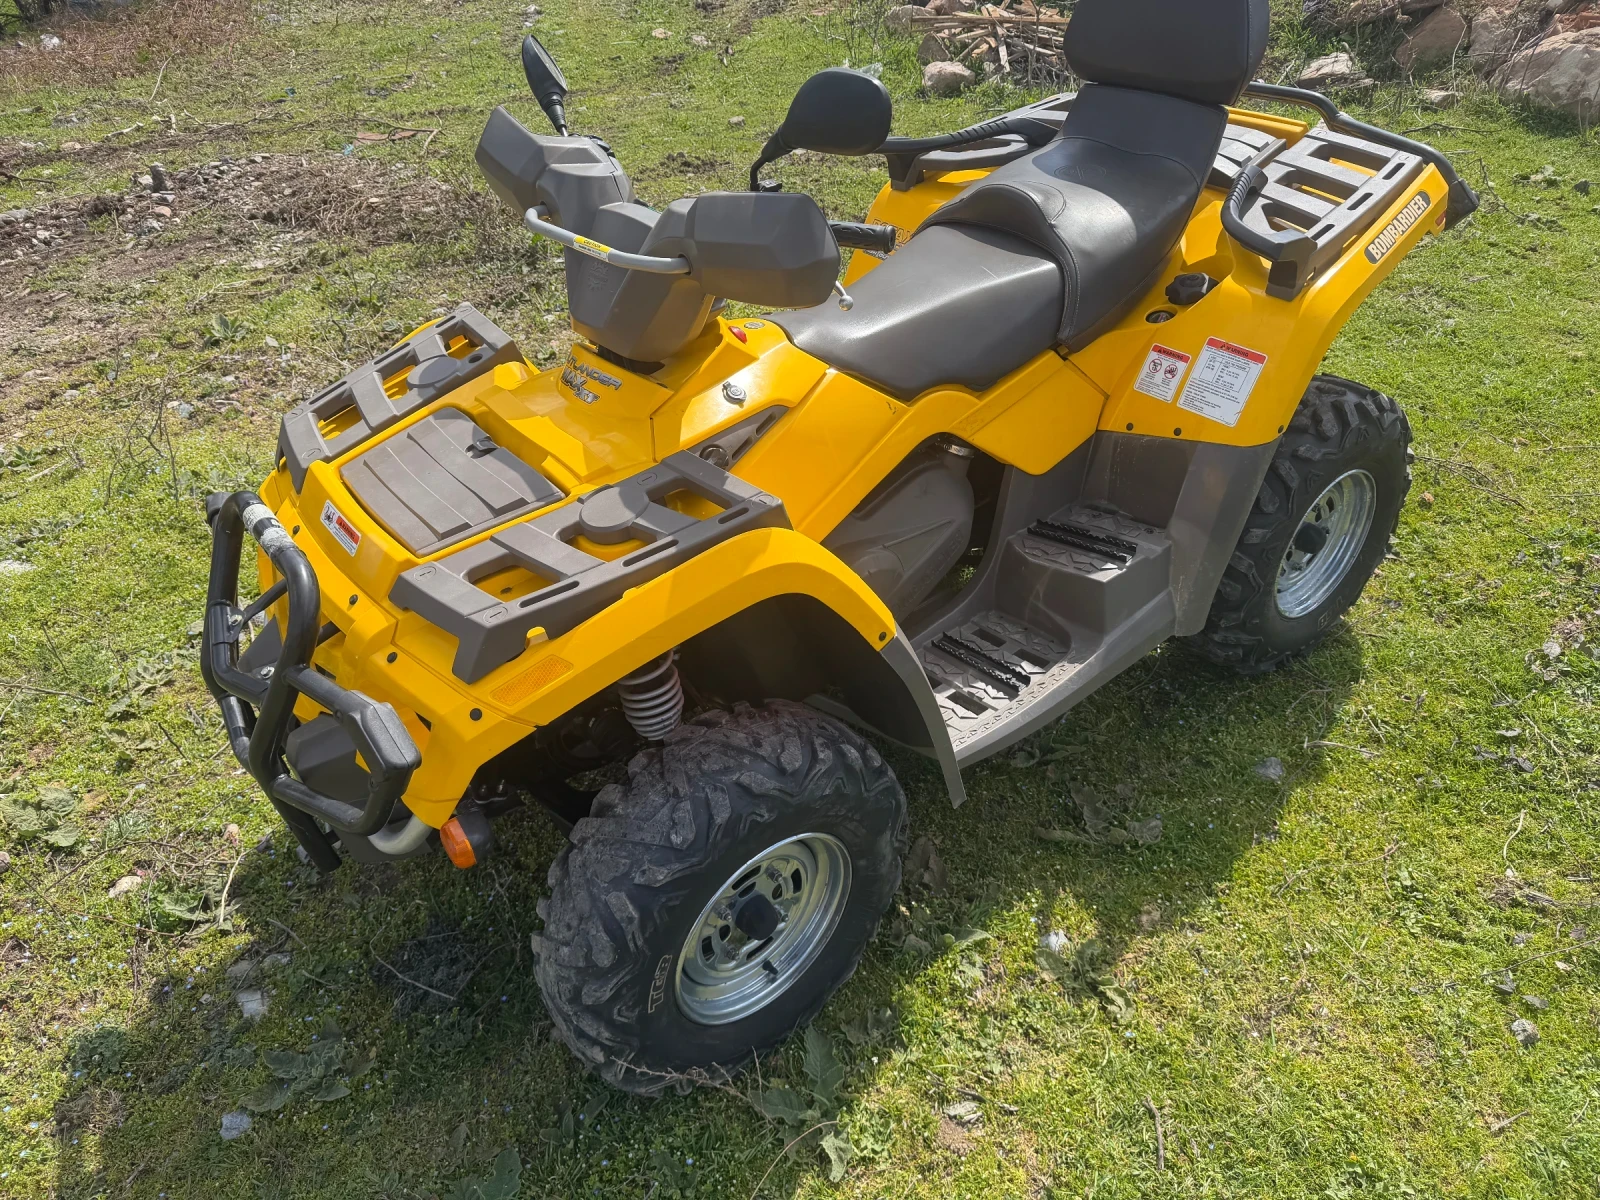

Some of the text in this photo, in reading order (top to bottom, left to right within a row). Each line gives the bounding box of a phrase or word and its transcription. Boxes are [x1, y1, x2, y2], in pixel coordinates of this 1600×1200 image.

[1367, 194, 1428, 261] BOMBARDIER
[1162, 348, 1184, 361] WARNING
[1225, 345, 1249, 358] WARNING
